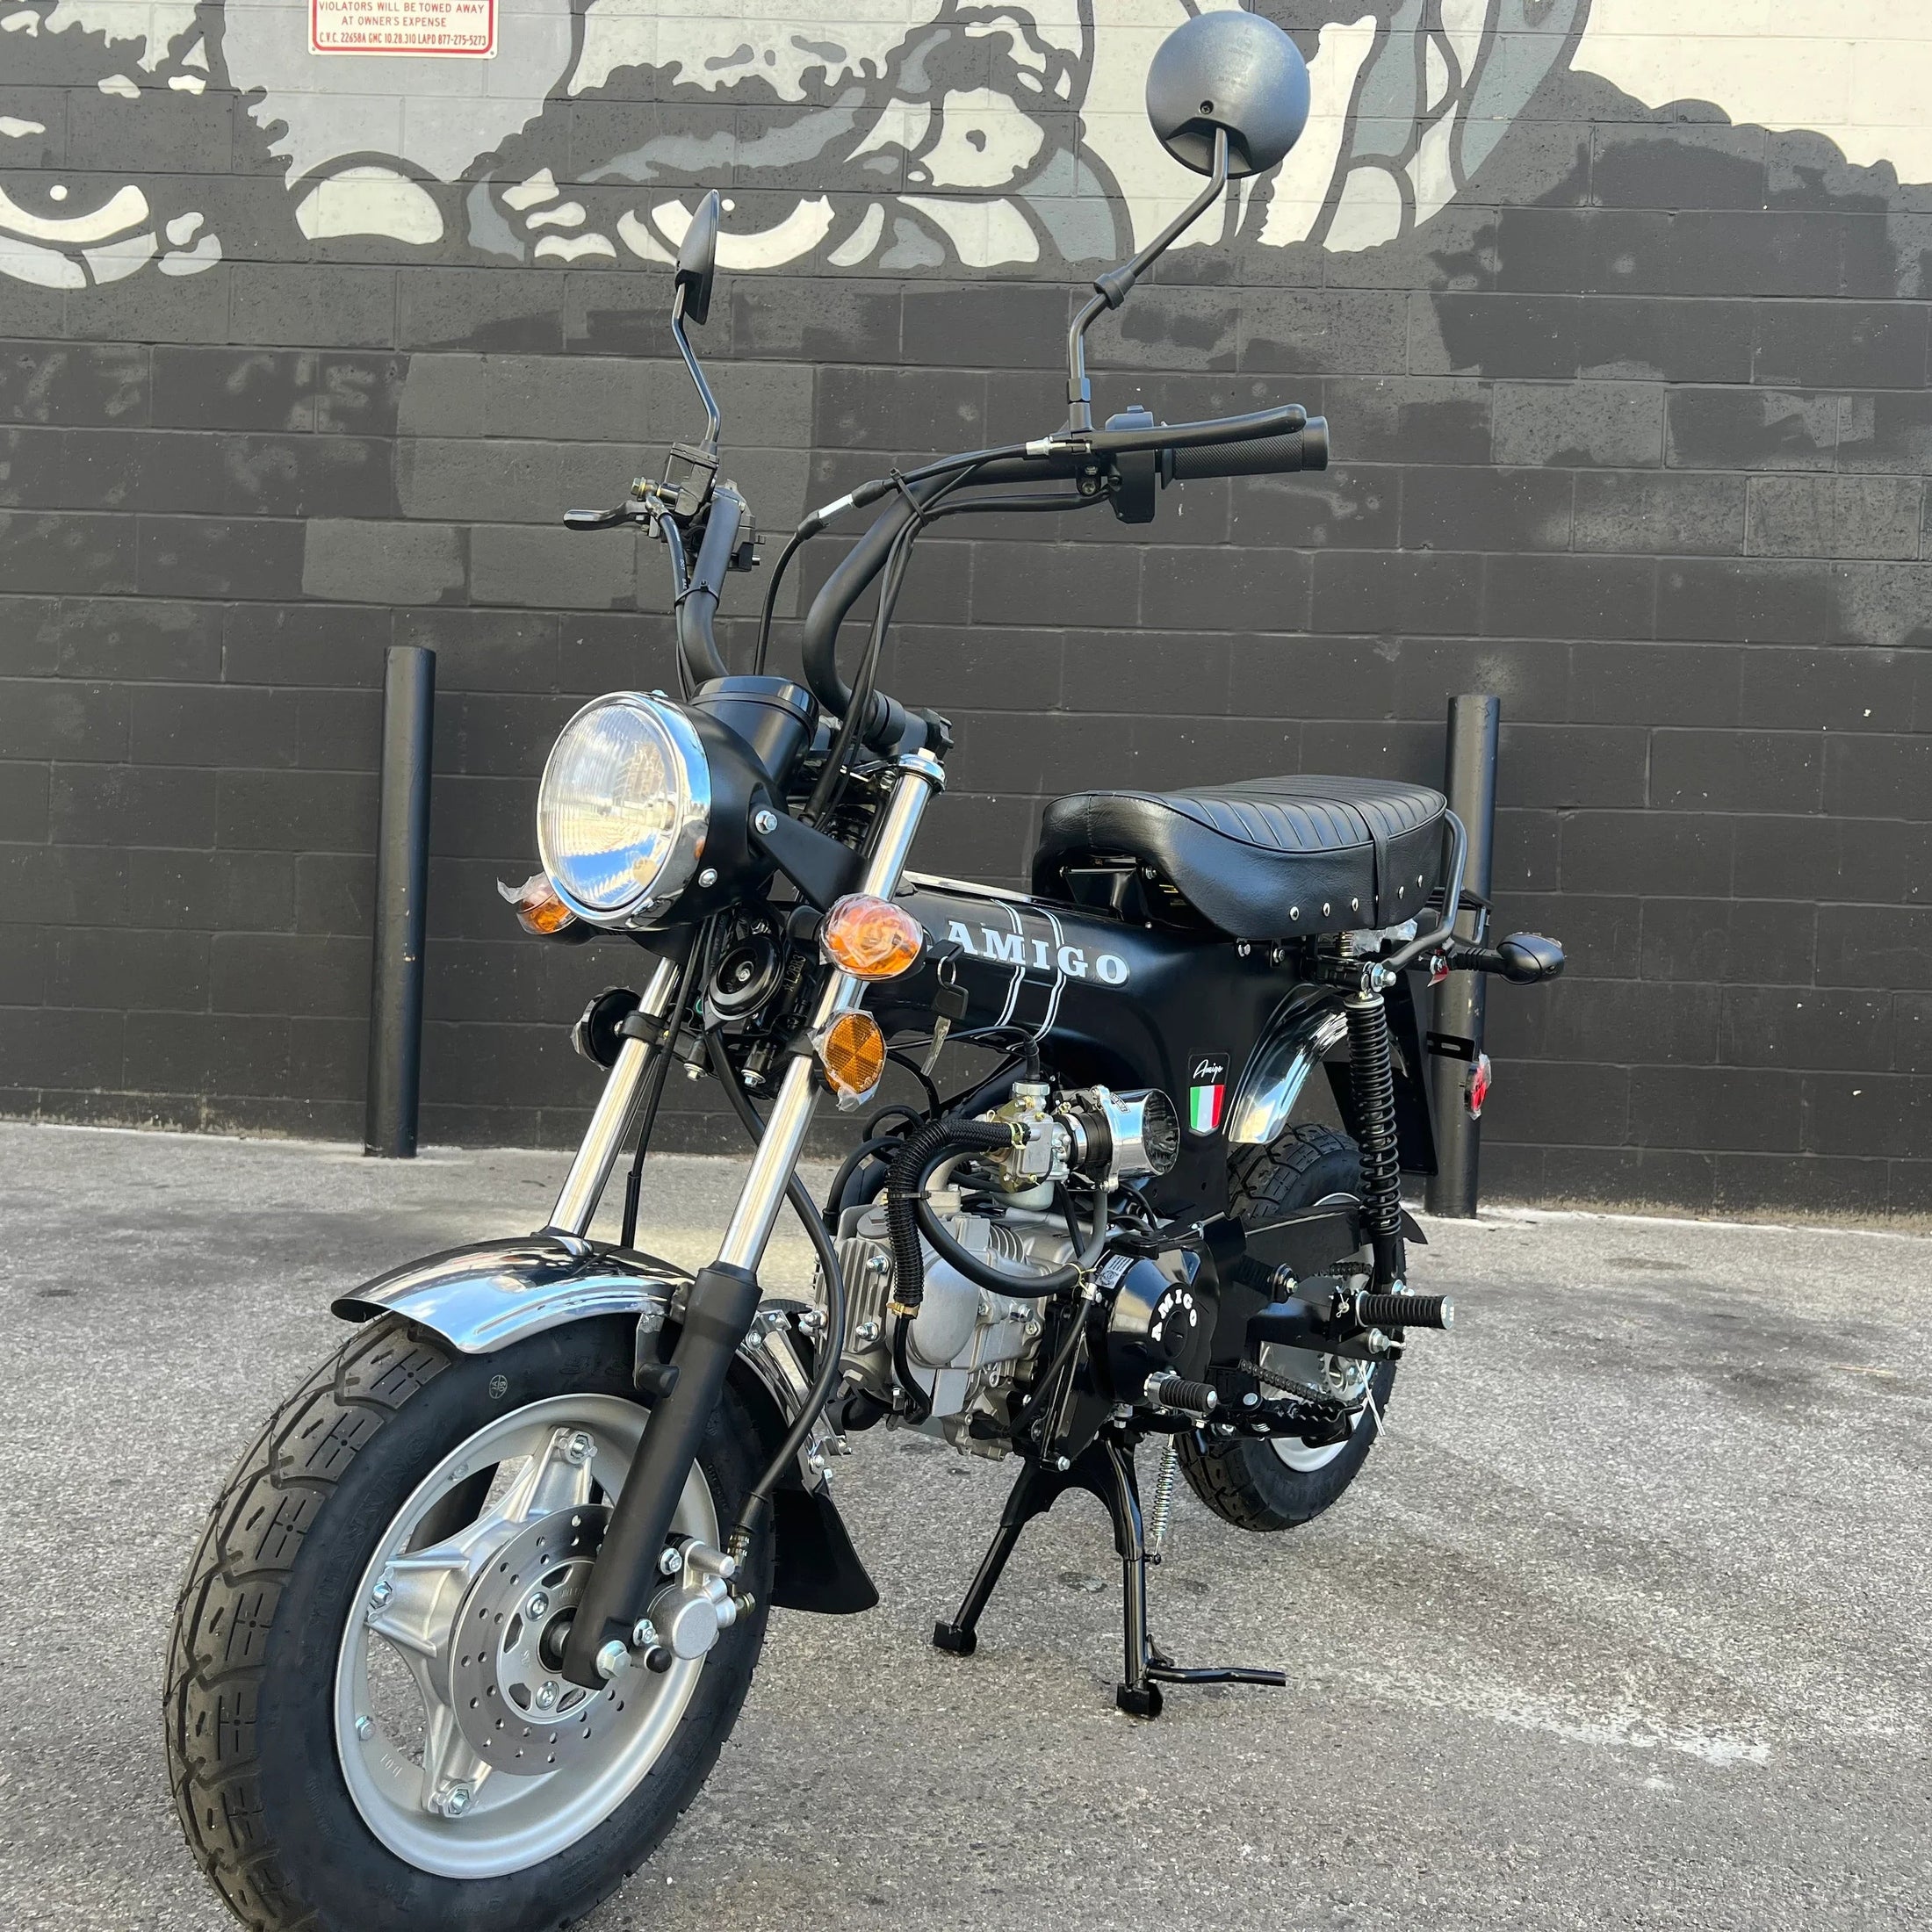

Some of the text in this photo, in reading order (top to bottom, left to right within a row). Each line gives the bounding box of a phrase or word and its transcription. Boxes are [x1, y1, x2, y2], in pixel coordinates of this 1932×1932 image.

[319, 2, 484, 14] VIOLATORS WILL BE TOWED AWAY
[342, 16, 447, 27] AT OWNER'S EXPENSE
[341, 32, 366, 43] 22658A
[385, 33, 416, 44] 10.28.310
[418, 34, 436, 45] LAPD
[438, 34, 487, 46] 877-275-5273
[948, 920, 1128, 984] AMIGO
[1193, 1059, 1224, 1084] Amigo
[1151, 1288, 1197, 1342] AMIGO
